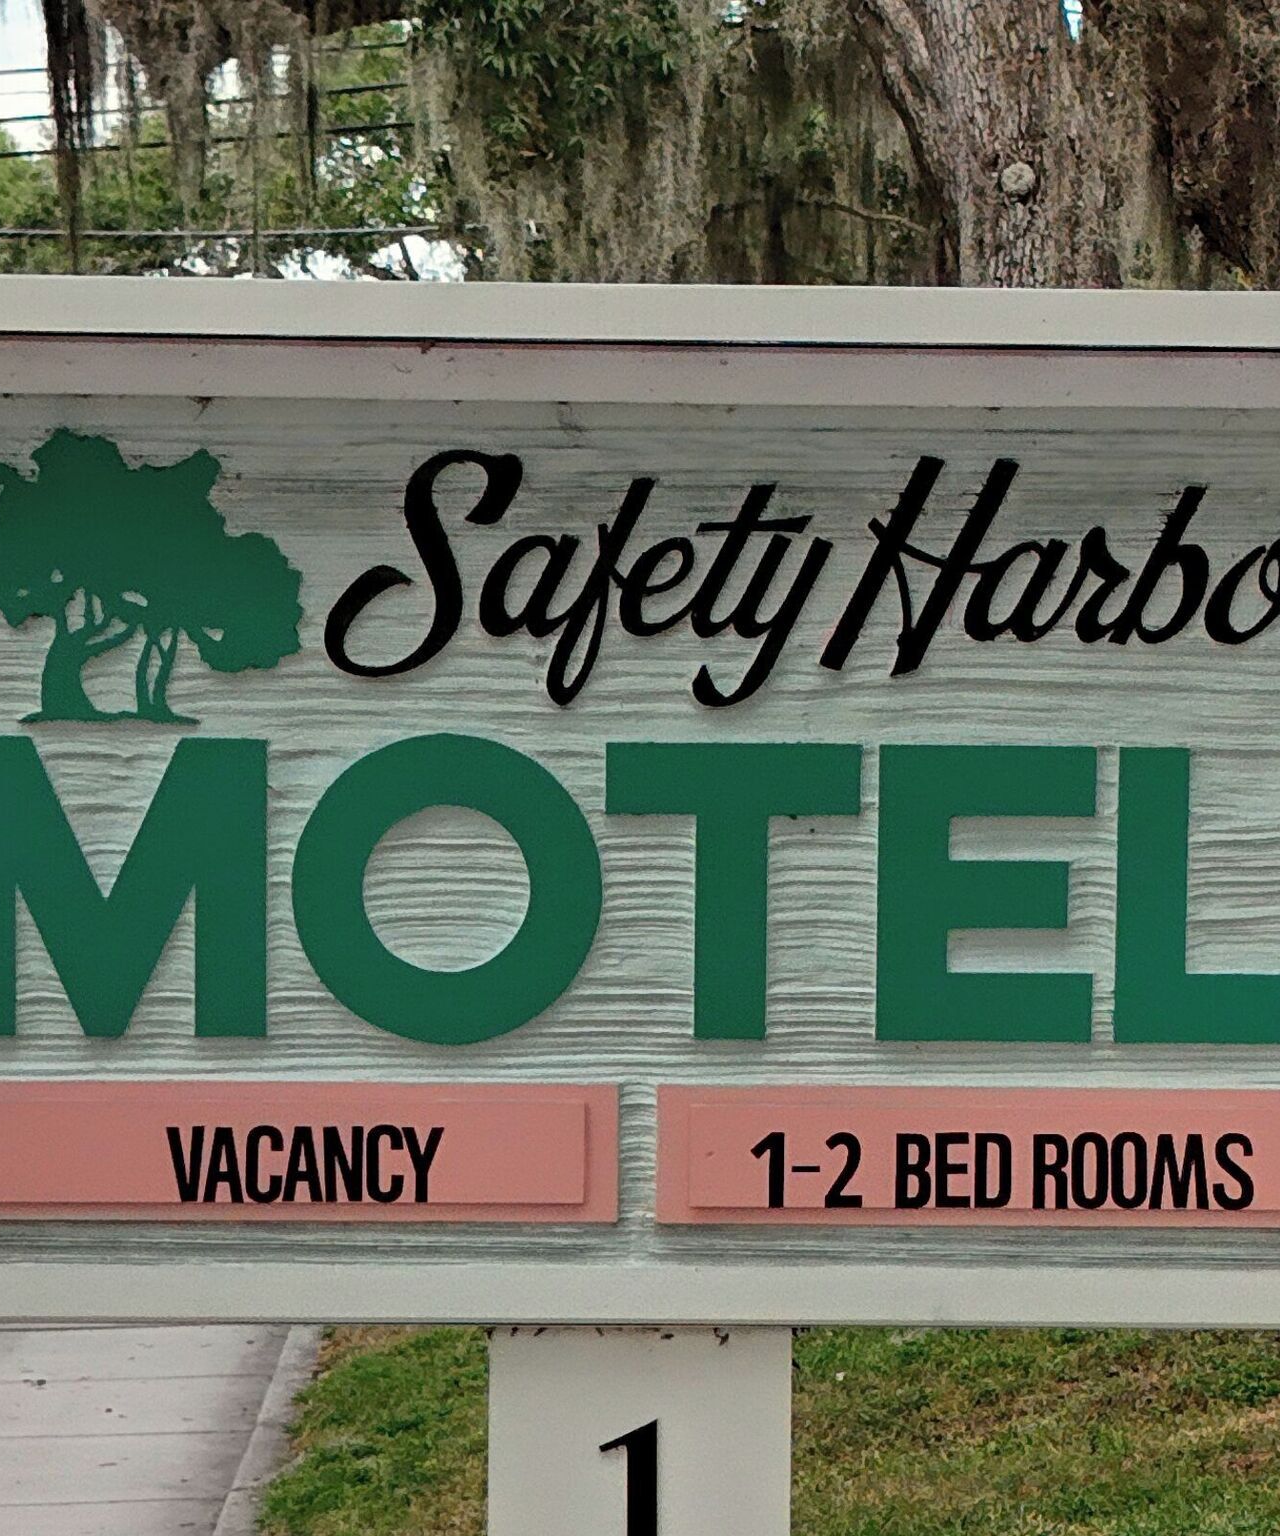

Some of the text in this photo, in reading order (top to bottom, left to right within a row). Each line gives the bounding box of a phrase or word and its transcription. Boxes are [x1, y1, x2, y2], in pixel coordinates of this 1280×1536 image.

[323, 448, 834, 711] Safety
[165, 1124, 445, 1206] VACANCY
[750, 1131, 863, 1210] 1-2
